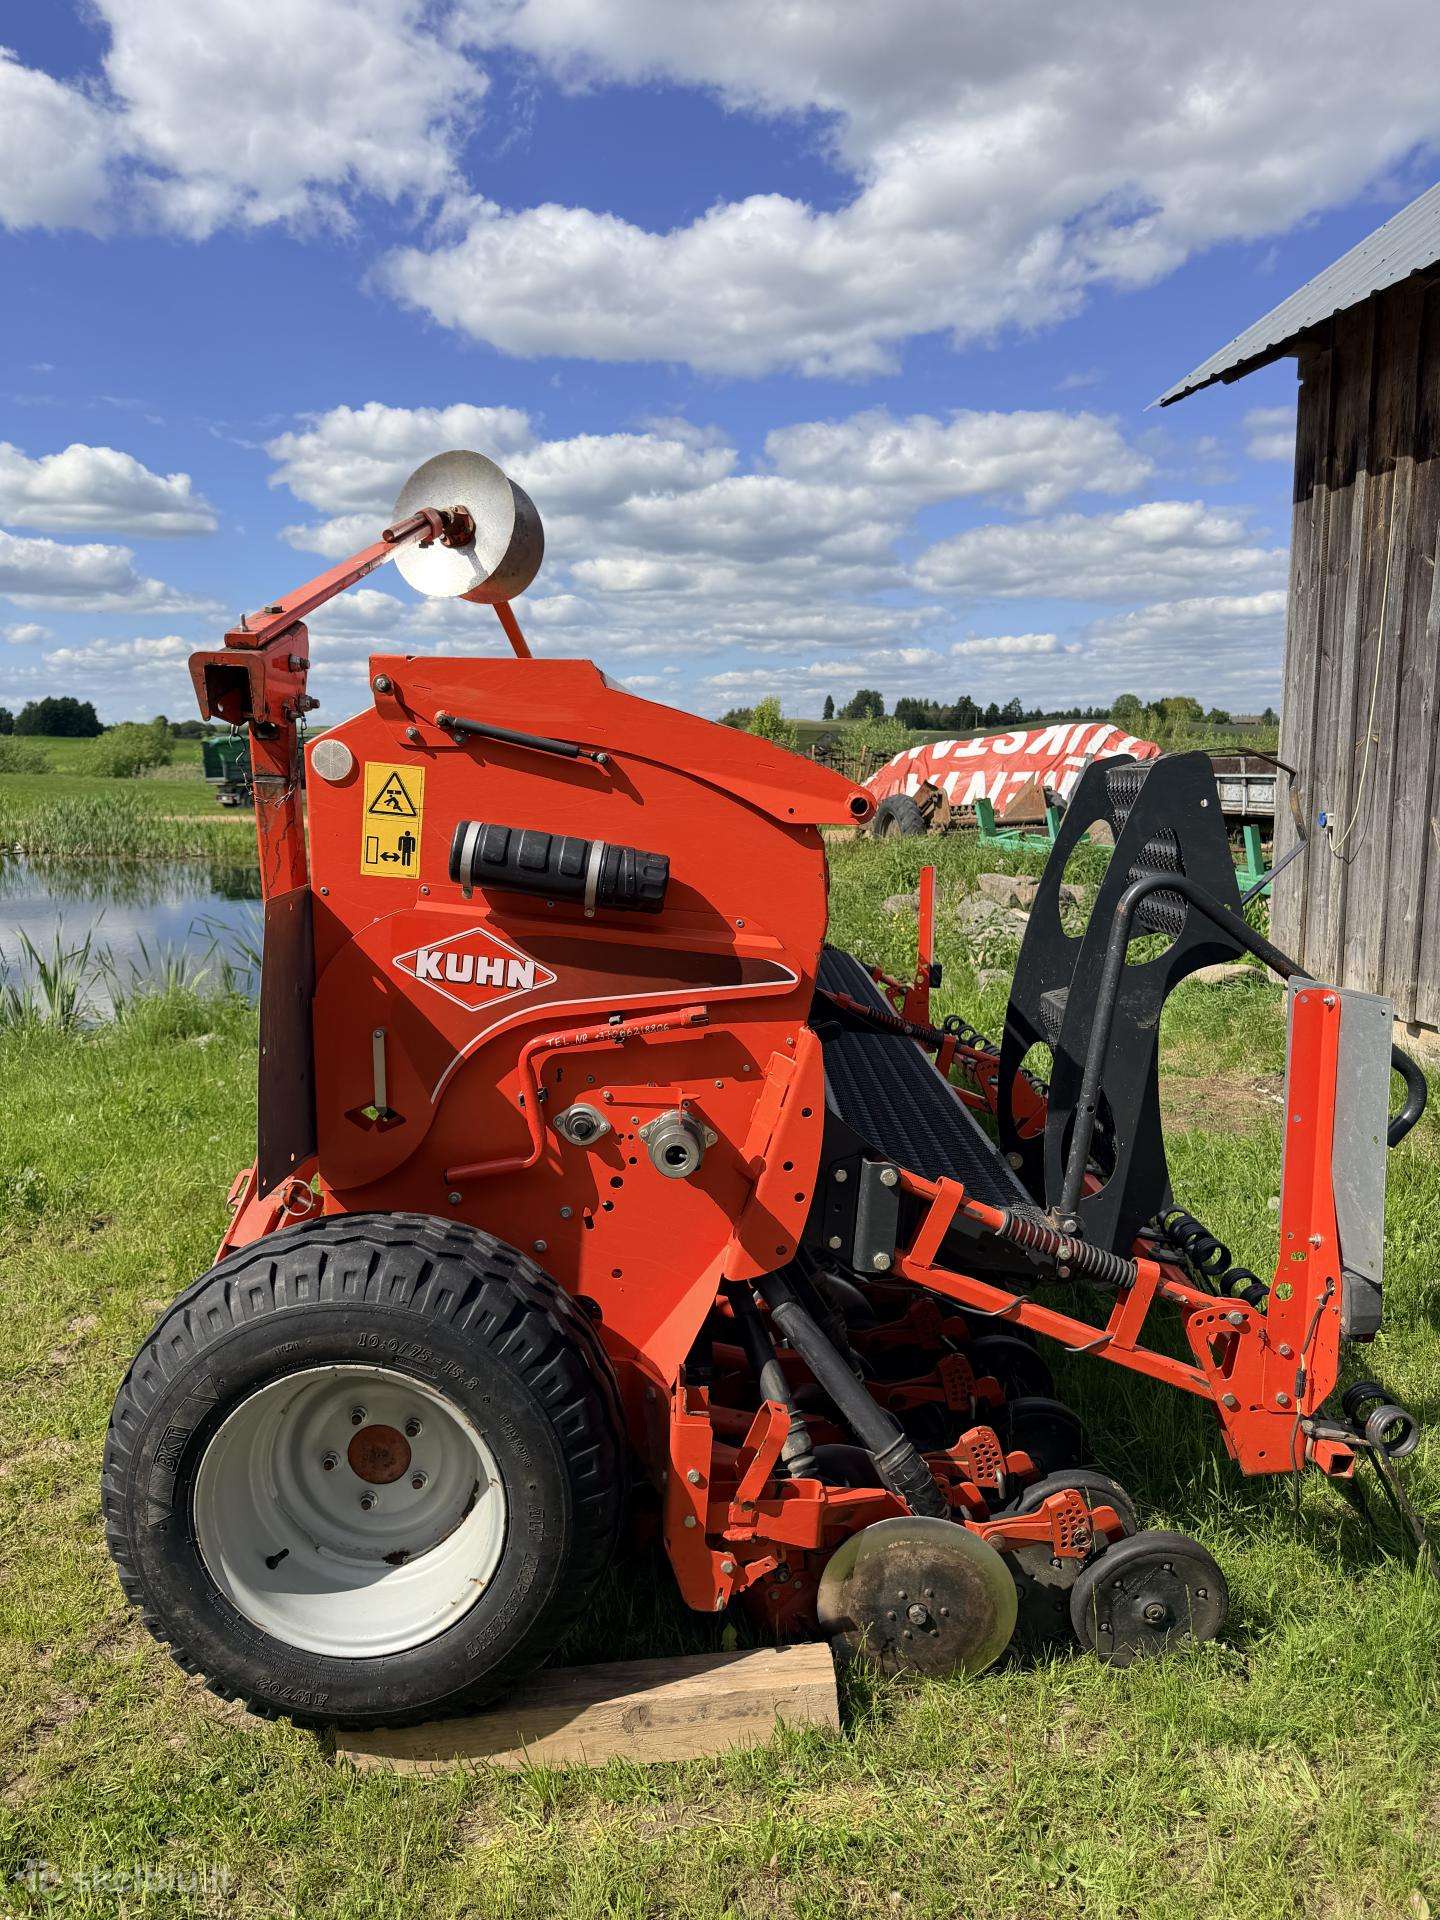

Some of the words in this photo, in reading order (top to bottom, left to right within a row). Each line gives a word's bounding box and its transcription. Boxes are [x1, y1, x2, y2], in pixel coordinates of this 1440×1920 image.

[414, 948, 537, 991] KUHN
[157, 1425, 191, 1475] BKT
[255, 1676, 329, 1707] AW702
